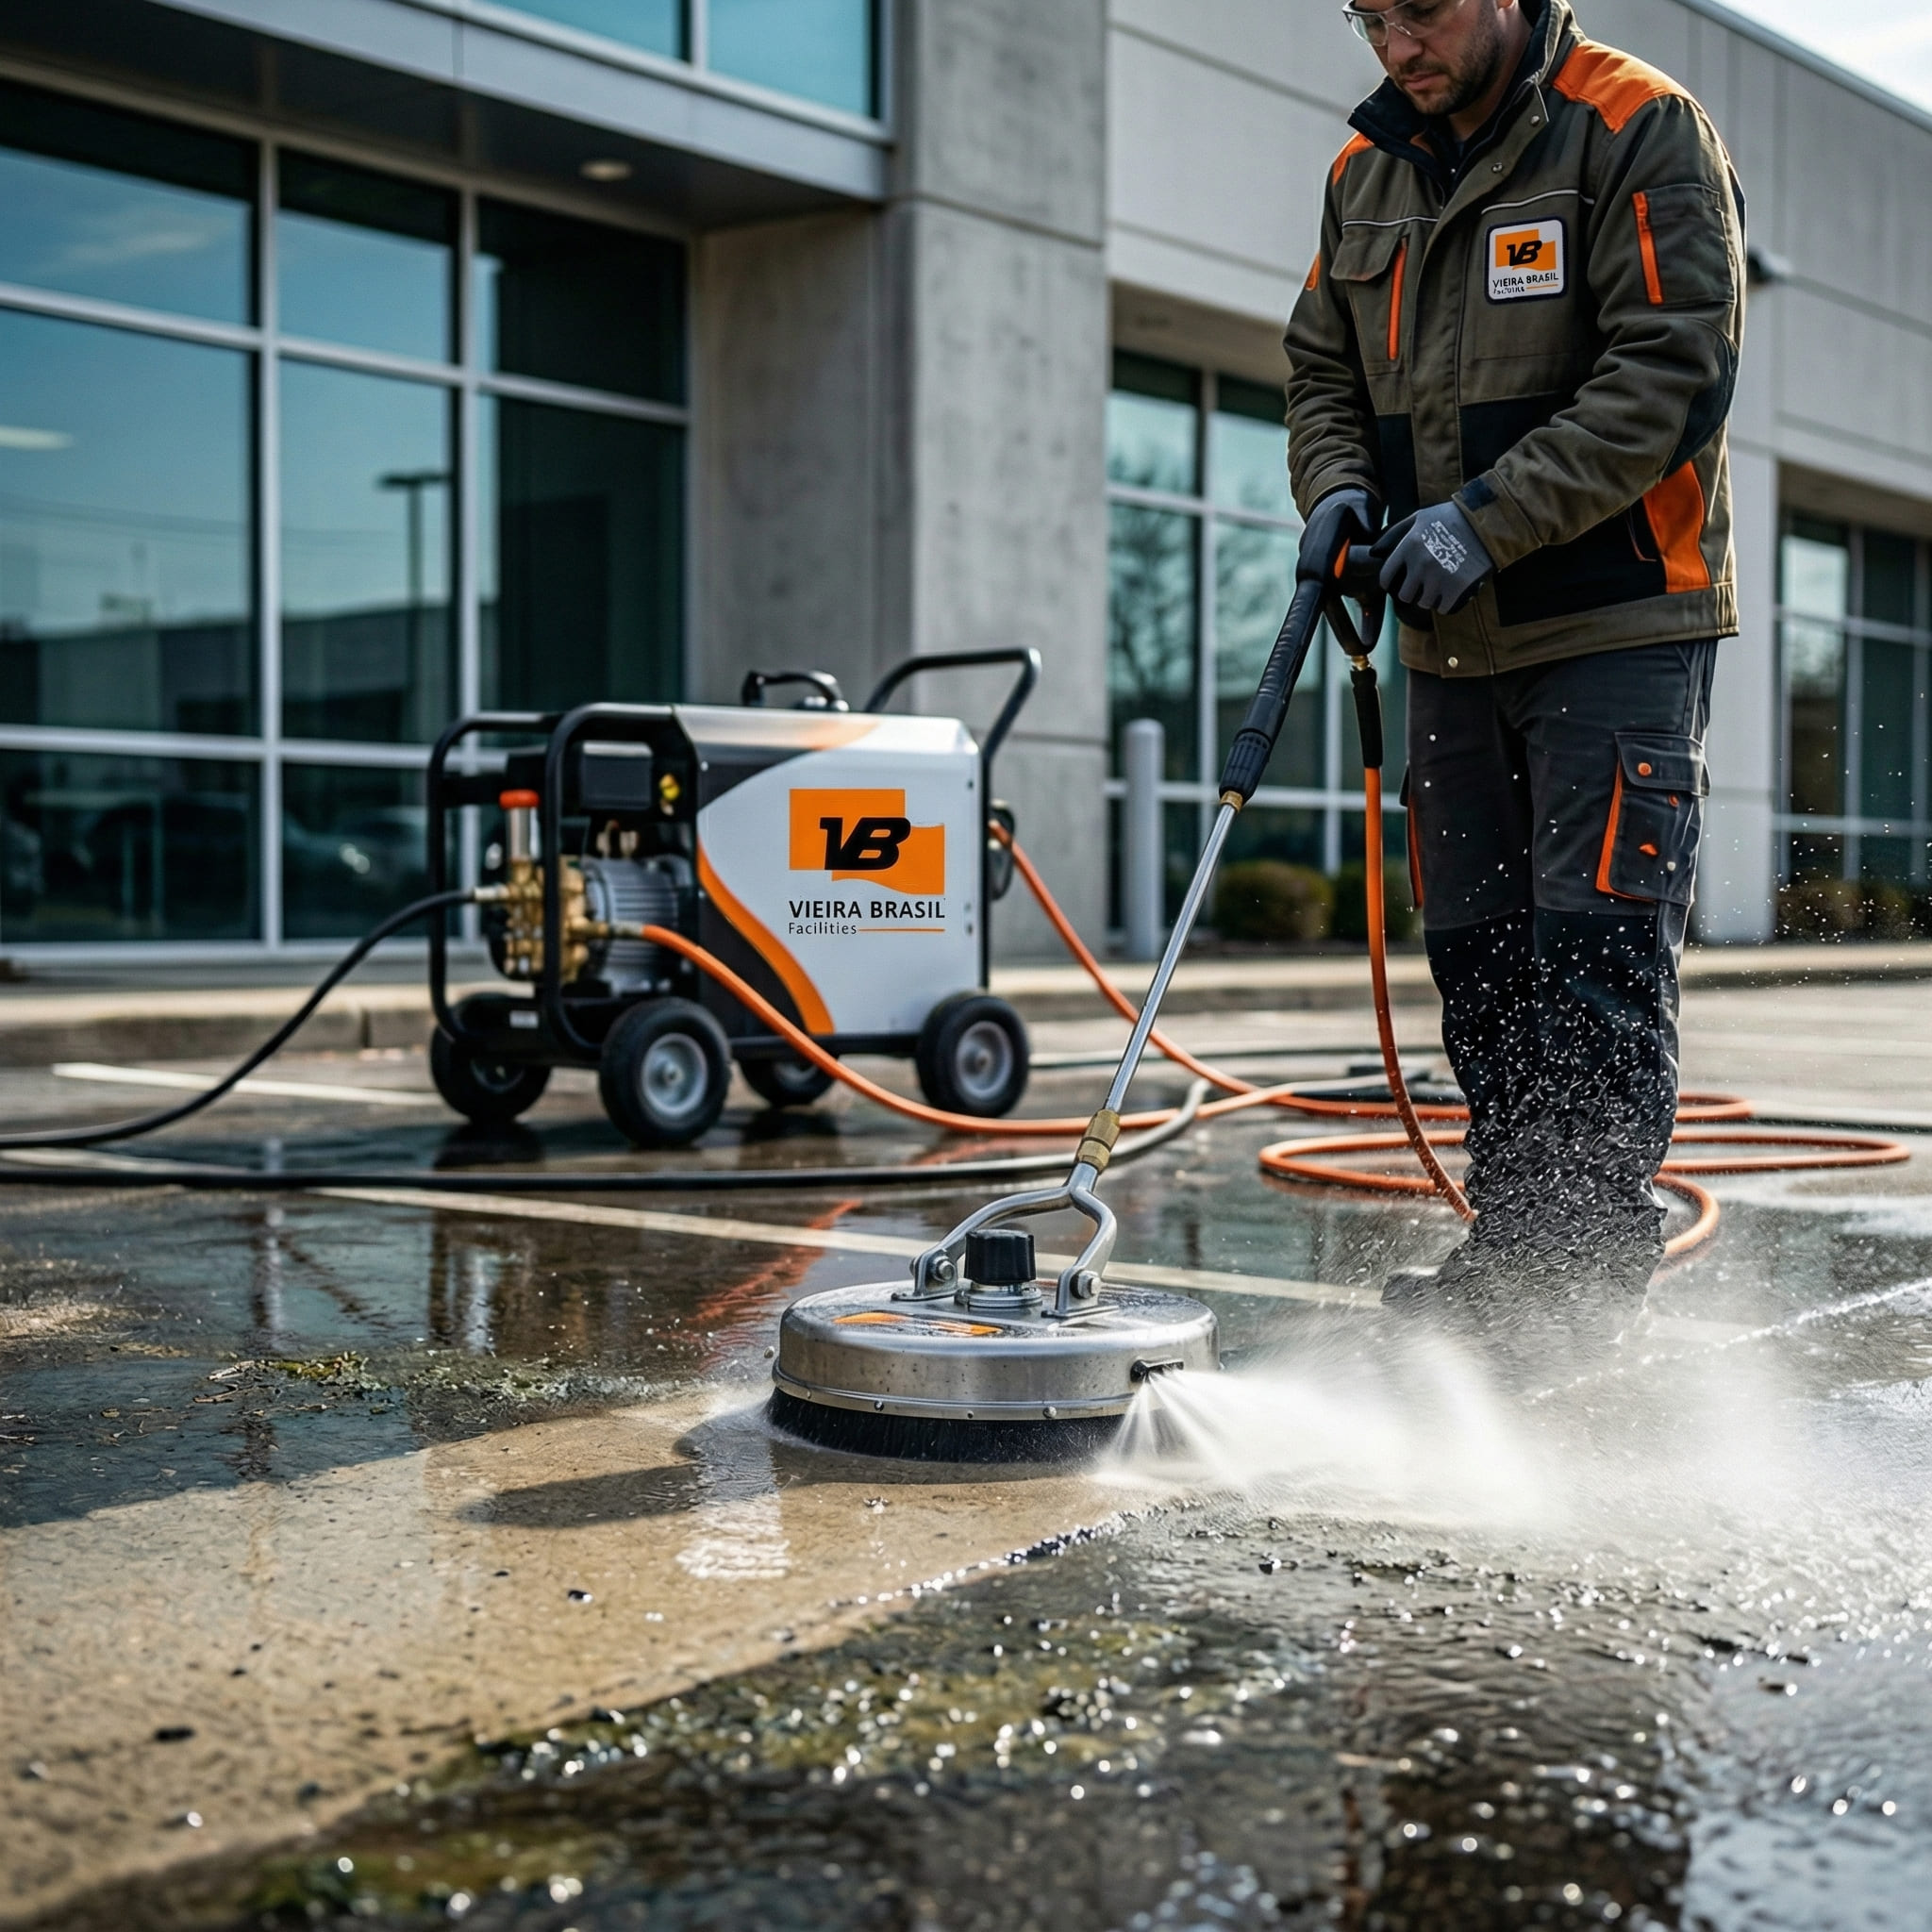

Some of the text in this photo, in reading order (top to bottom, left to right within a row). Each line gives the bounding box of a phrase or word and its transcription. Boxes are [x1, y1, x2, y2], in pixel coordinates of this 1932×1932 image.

[1492, 273, 1559, 288] VIEIRA BRASIL
[789, 901, 945, 919] VIEIRA BRASIL
[789, 922, 858, 935] Facilities
